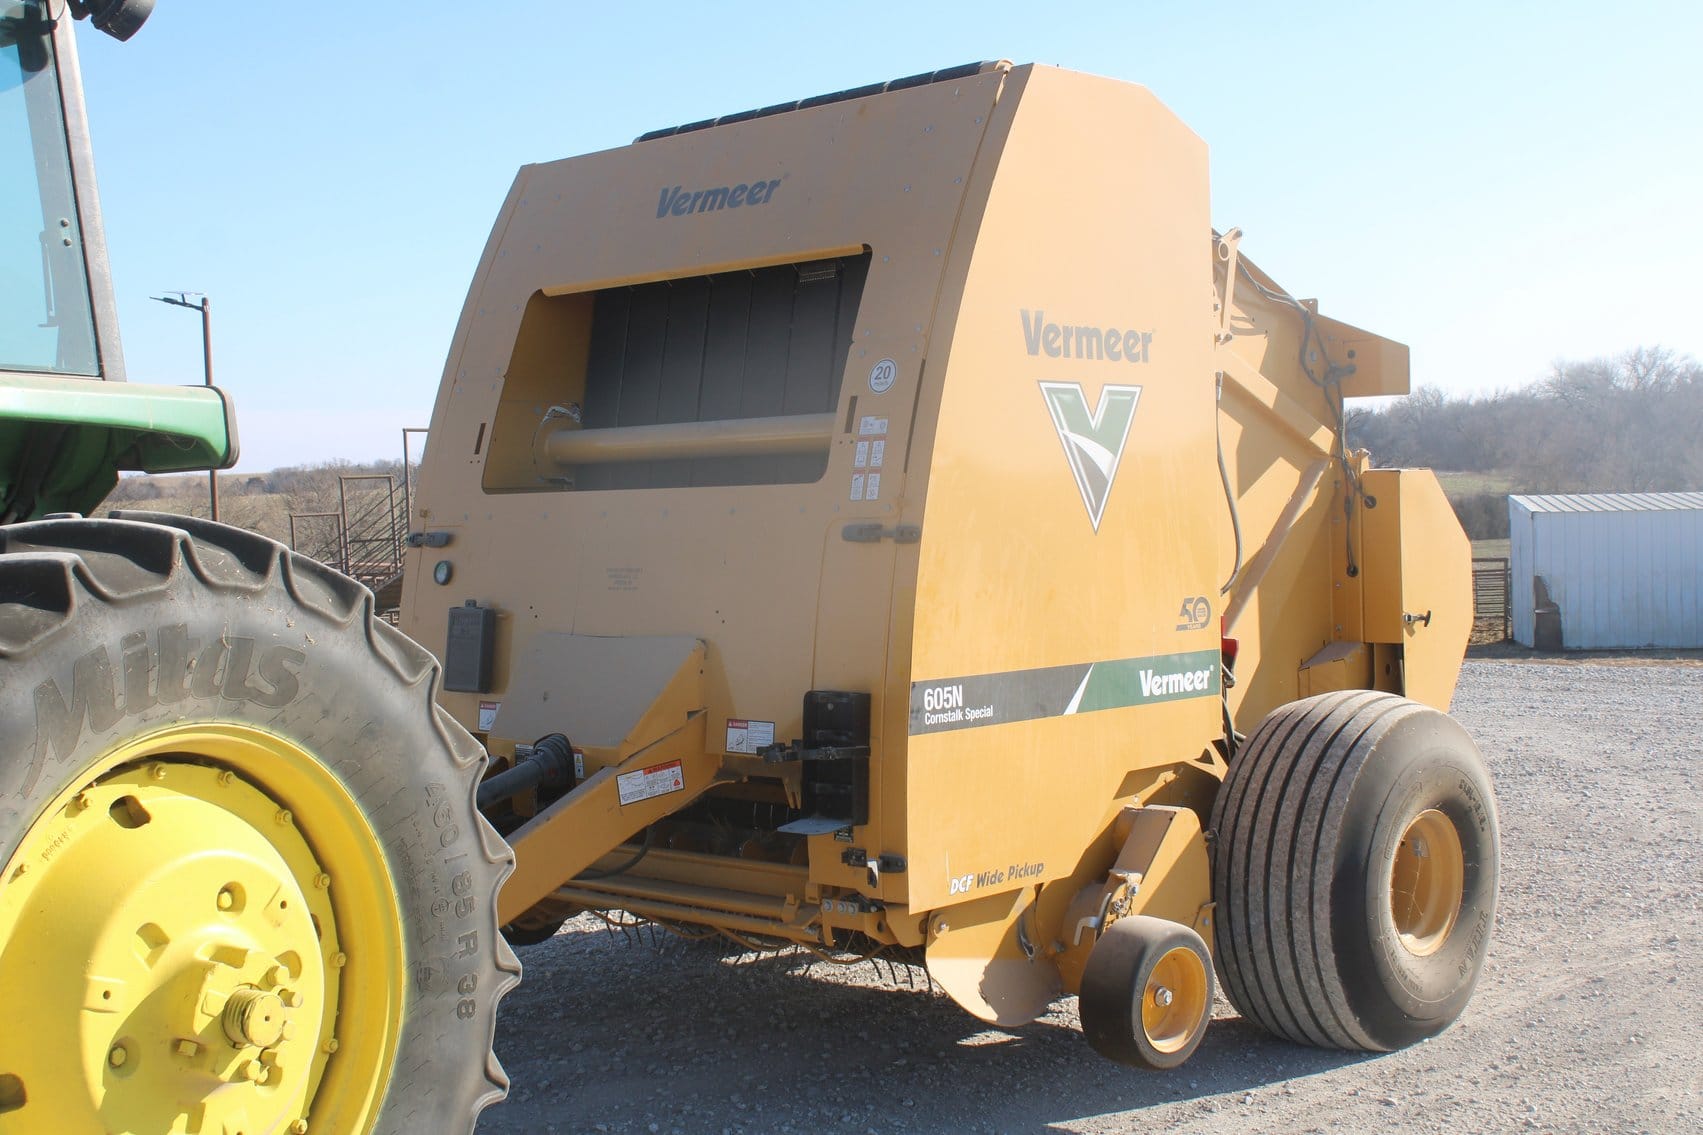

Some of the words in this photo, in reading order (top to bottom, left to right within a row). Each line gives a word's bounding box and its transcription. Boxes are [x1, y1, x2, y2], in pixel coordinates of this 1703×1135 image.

[656, 178, 782, 219] Vermeer
[1020, 308, 1153, 363] Vermeer
[874, 365, 891, 380] 20
[1178, 596, 1211, 629] 50
[924, 684, 963, 711] 605N
[1139, 668, 1211, 697] Vermeer
[19, 622, 307, 801] Mitas
[924, 707, 963, 726] Cornstalk
[965, 704, 993, 722] Special
[950, 873, 974, 896] DCF
[976, 868, 1004, 888] Wide
[1007, 862, 1044, 881] Pickup
[457, 929, 478, 960] R
[456, 972, 478, 1020] 38
